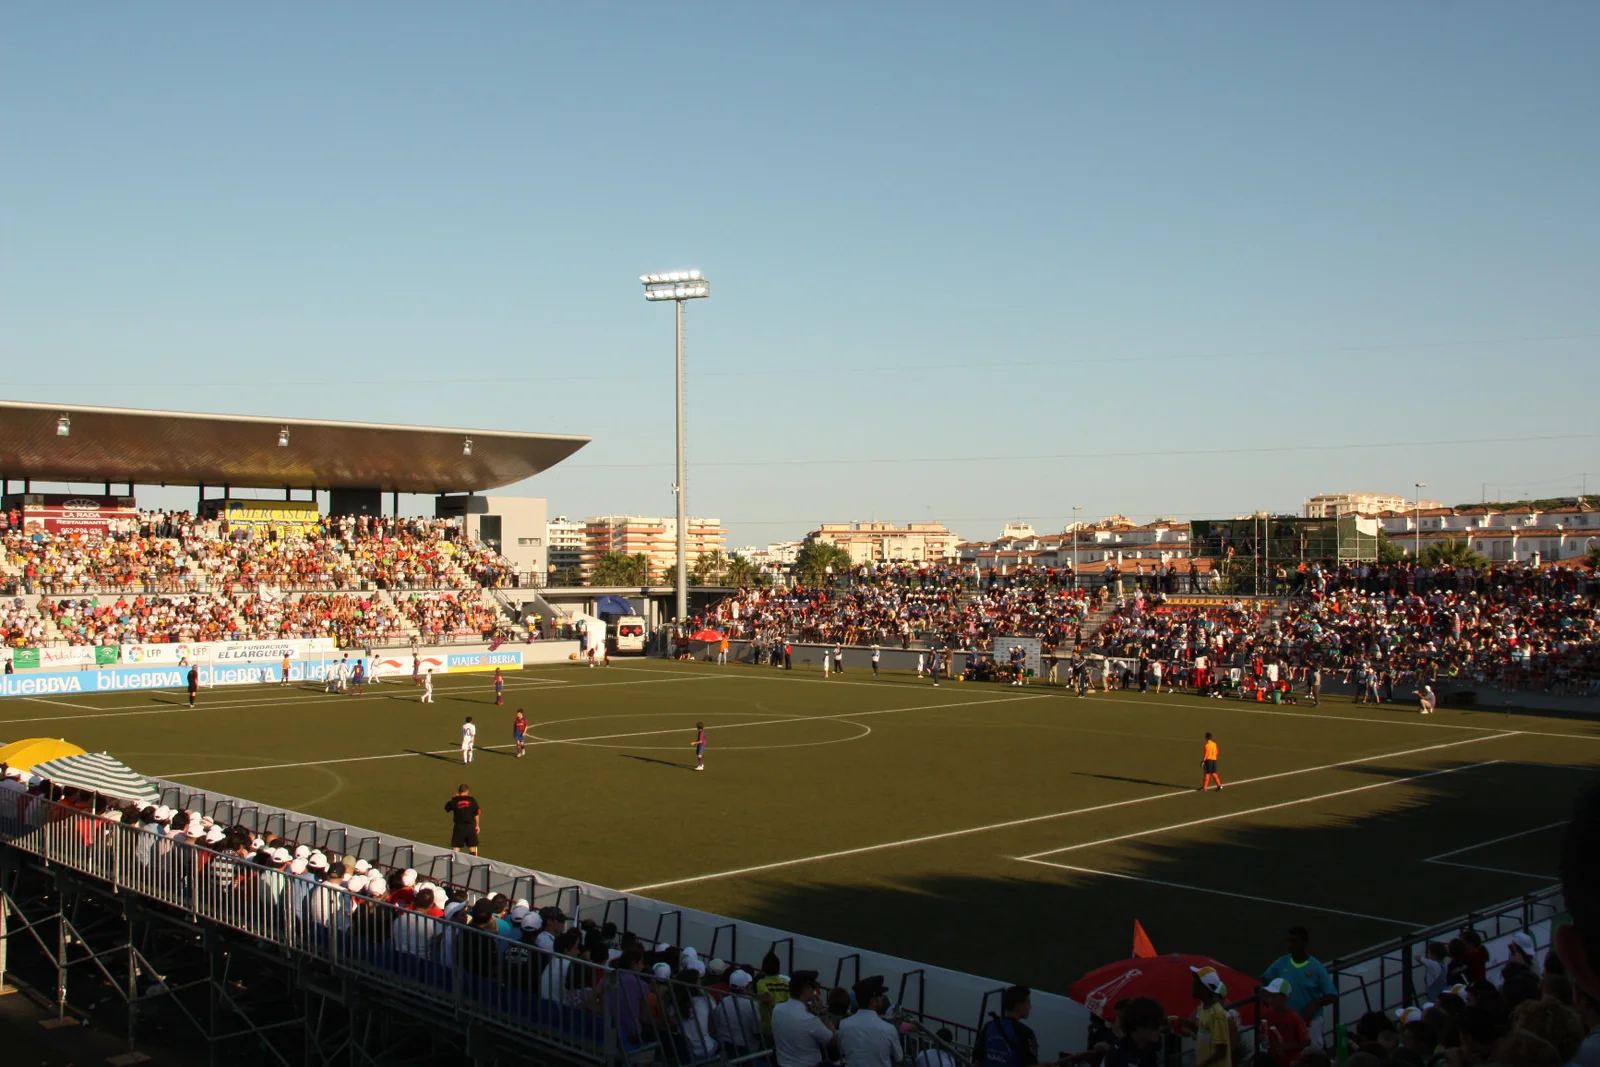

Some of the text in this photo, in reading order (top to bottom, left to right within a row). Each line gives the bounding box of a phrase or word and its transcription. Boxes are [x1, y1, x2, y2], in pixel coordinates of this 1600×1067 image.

[238, 507, 313, 519] MERCASUR
[146, 648, 161, 658] LFP
[192, 647, 207, 656] LFP
[218, 649, 295, 659] EL LARGUERO
[451, 654, 516, 666] VIAJES IBERIA
[0, 674, 82, 696] lueBBVA
[97, 670, 183, 691] blueBBVA
